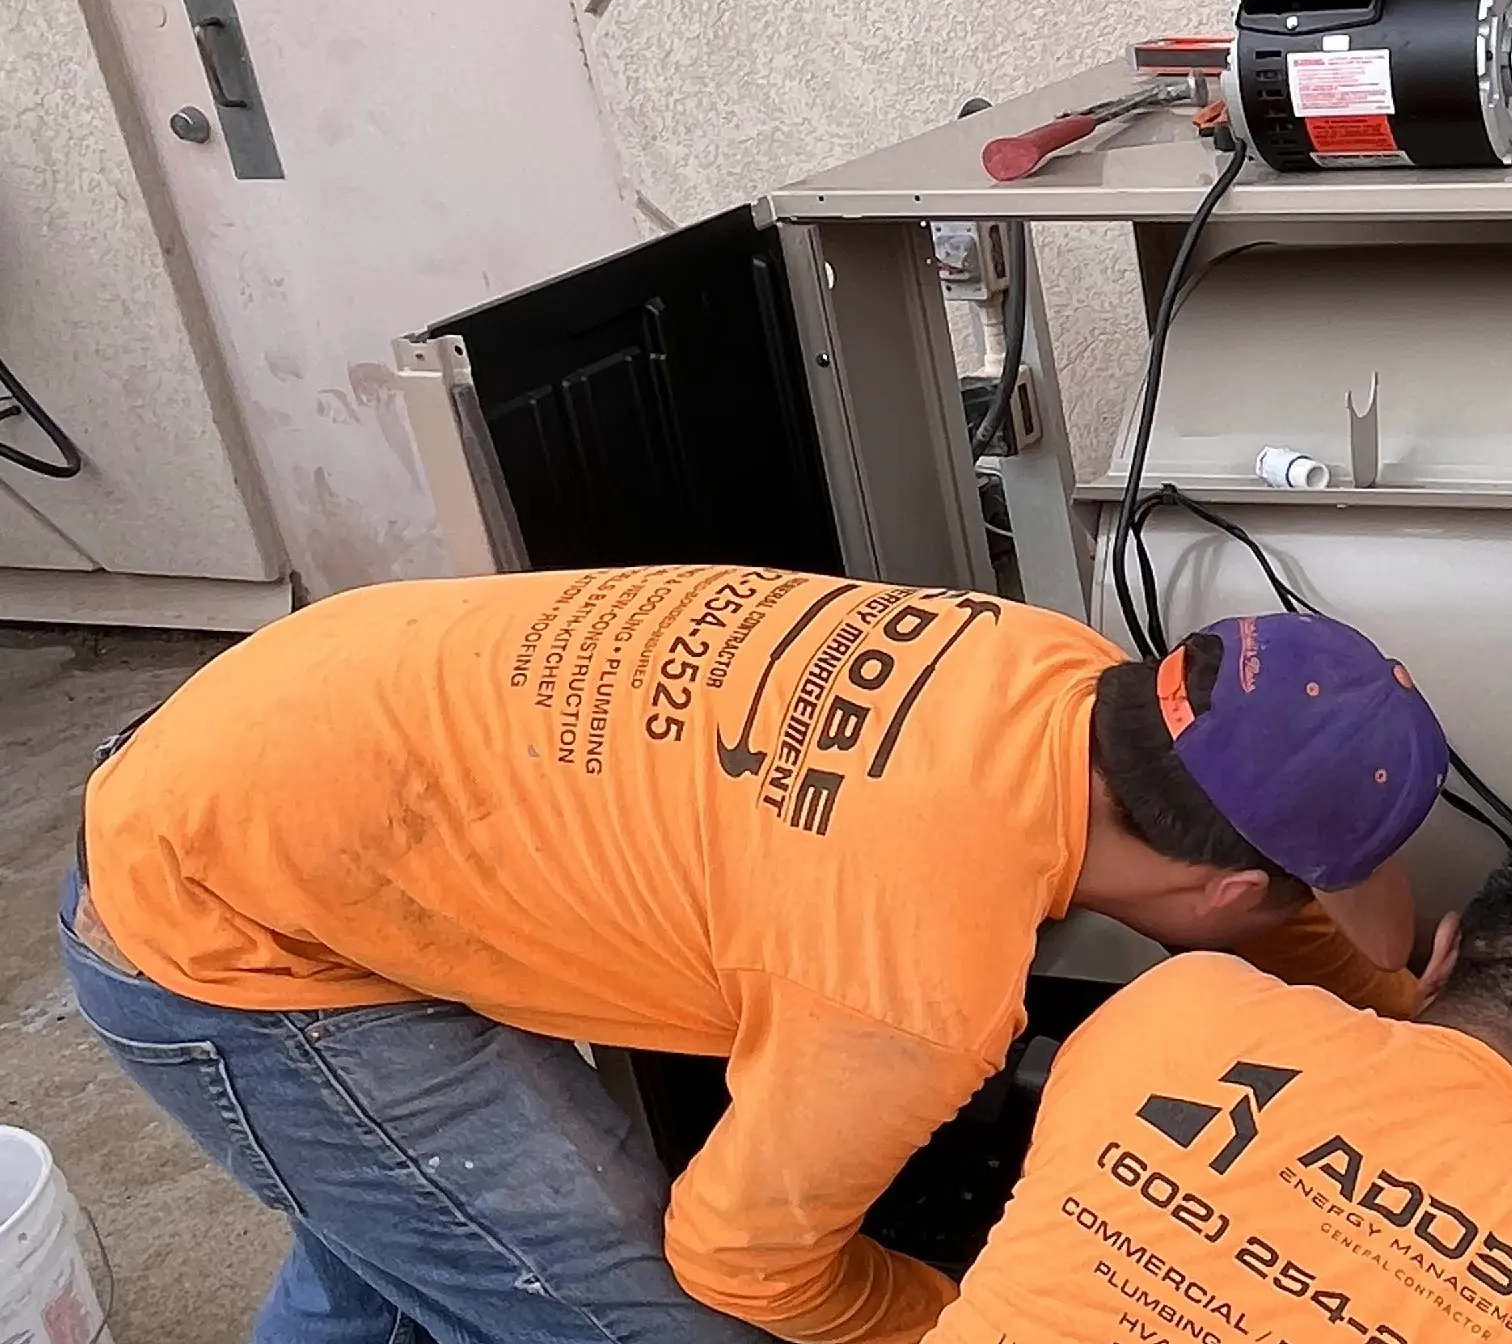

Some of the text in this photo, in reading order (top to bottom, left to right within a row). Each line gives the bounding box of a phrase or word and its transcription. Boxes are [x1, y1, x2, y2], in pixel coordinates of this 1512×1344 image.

[510, 612, 557, 688] ROOFING
[613, 587, 672, 643] COOLING
[644, 570, 783, 743] 2-254-2525
[705, 609, 767, 689] CONTRACTOR
[584, 657, 622, 776] PLUMBING
[762, 621, 864, 819] MANAGEMENT
[790, 590, 969, 837] DOBE
[1096, 1141, 1230, 1244] (602)
[1279, 1166, 1381, 1237] ENERGY
[1061, 1196, 1249, 1336] COMMERCIAL
[1320, 1222, 1492, 1341] GENERAL CONTRACTOR
